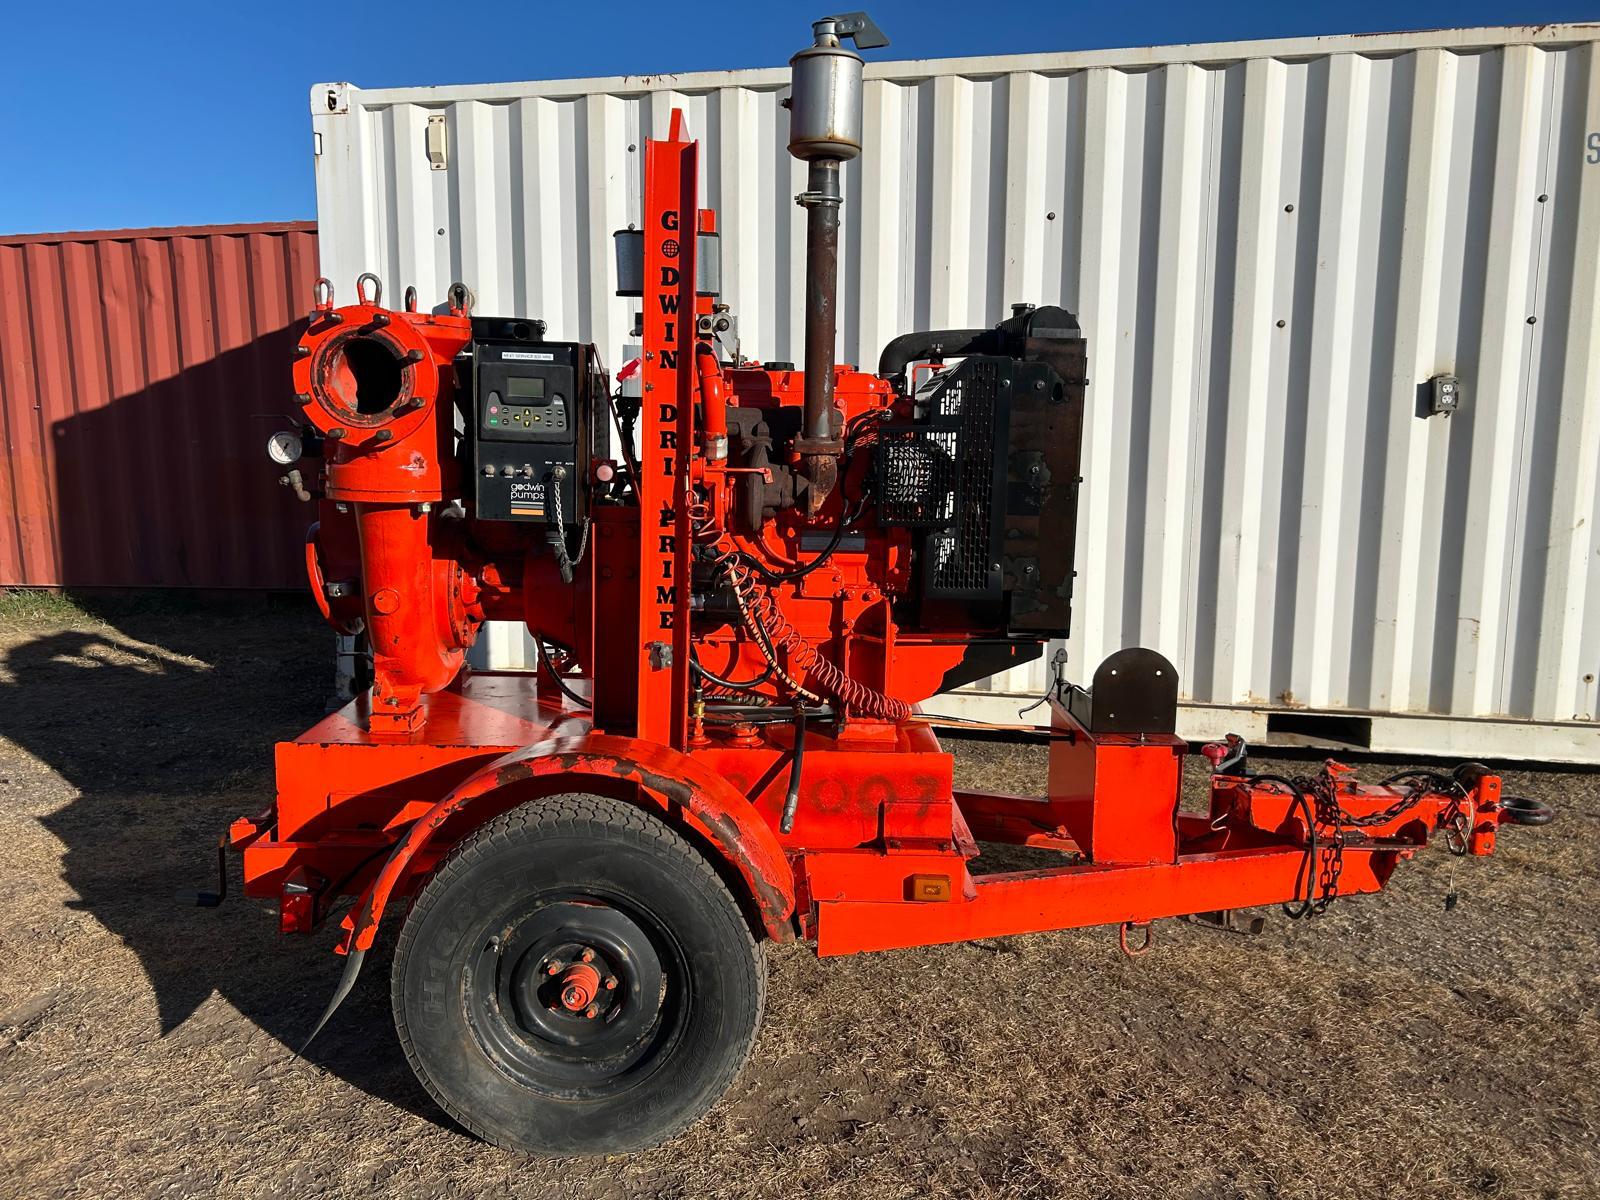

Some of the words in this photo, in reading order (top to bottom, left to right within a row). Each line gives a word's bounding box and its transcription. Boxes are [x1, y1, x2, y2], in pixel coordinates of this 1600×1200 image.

[659, 210, 680, 369] GODWIN
[511, 482, 544, 492] godwin
[511, 490, 544, 500] pumps
[656, 509, 678, 630] PRIME
